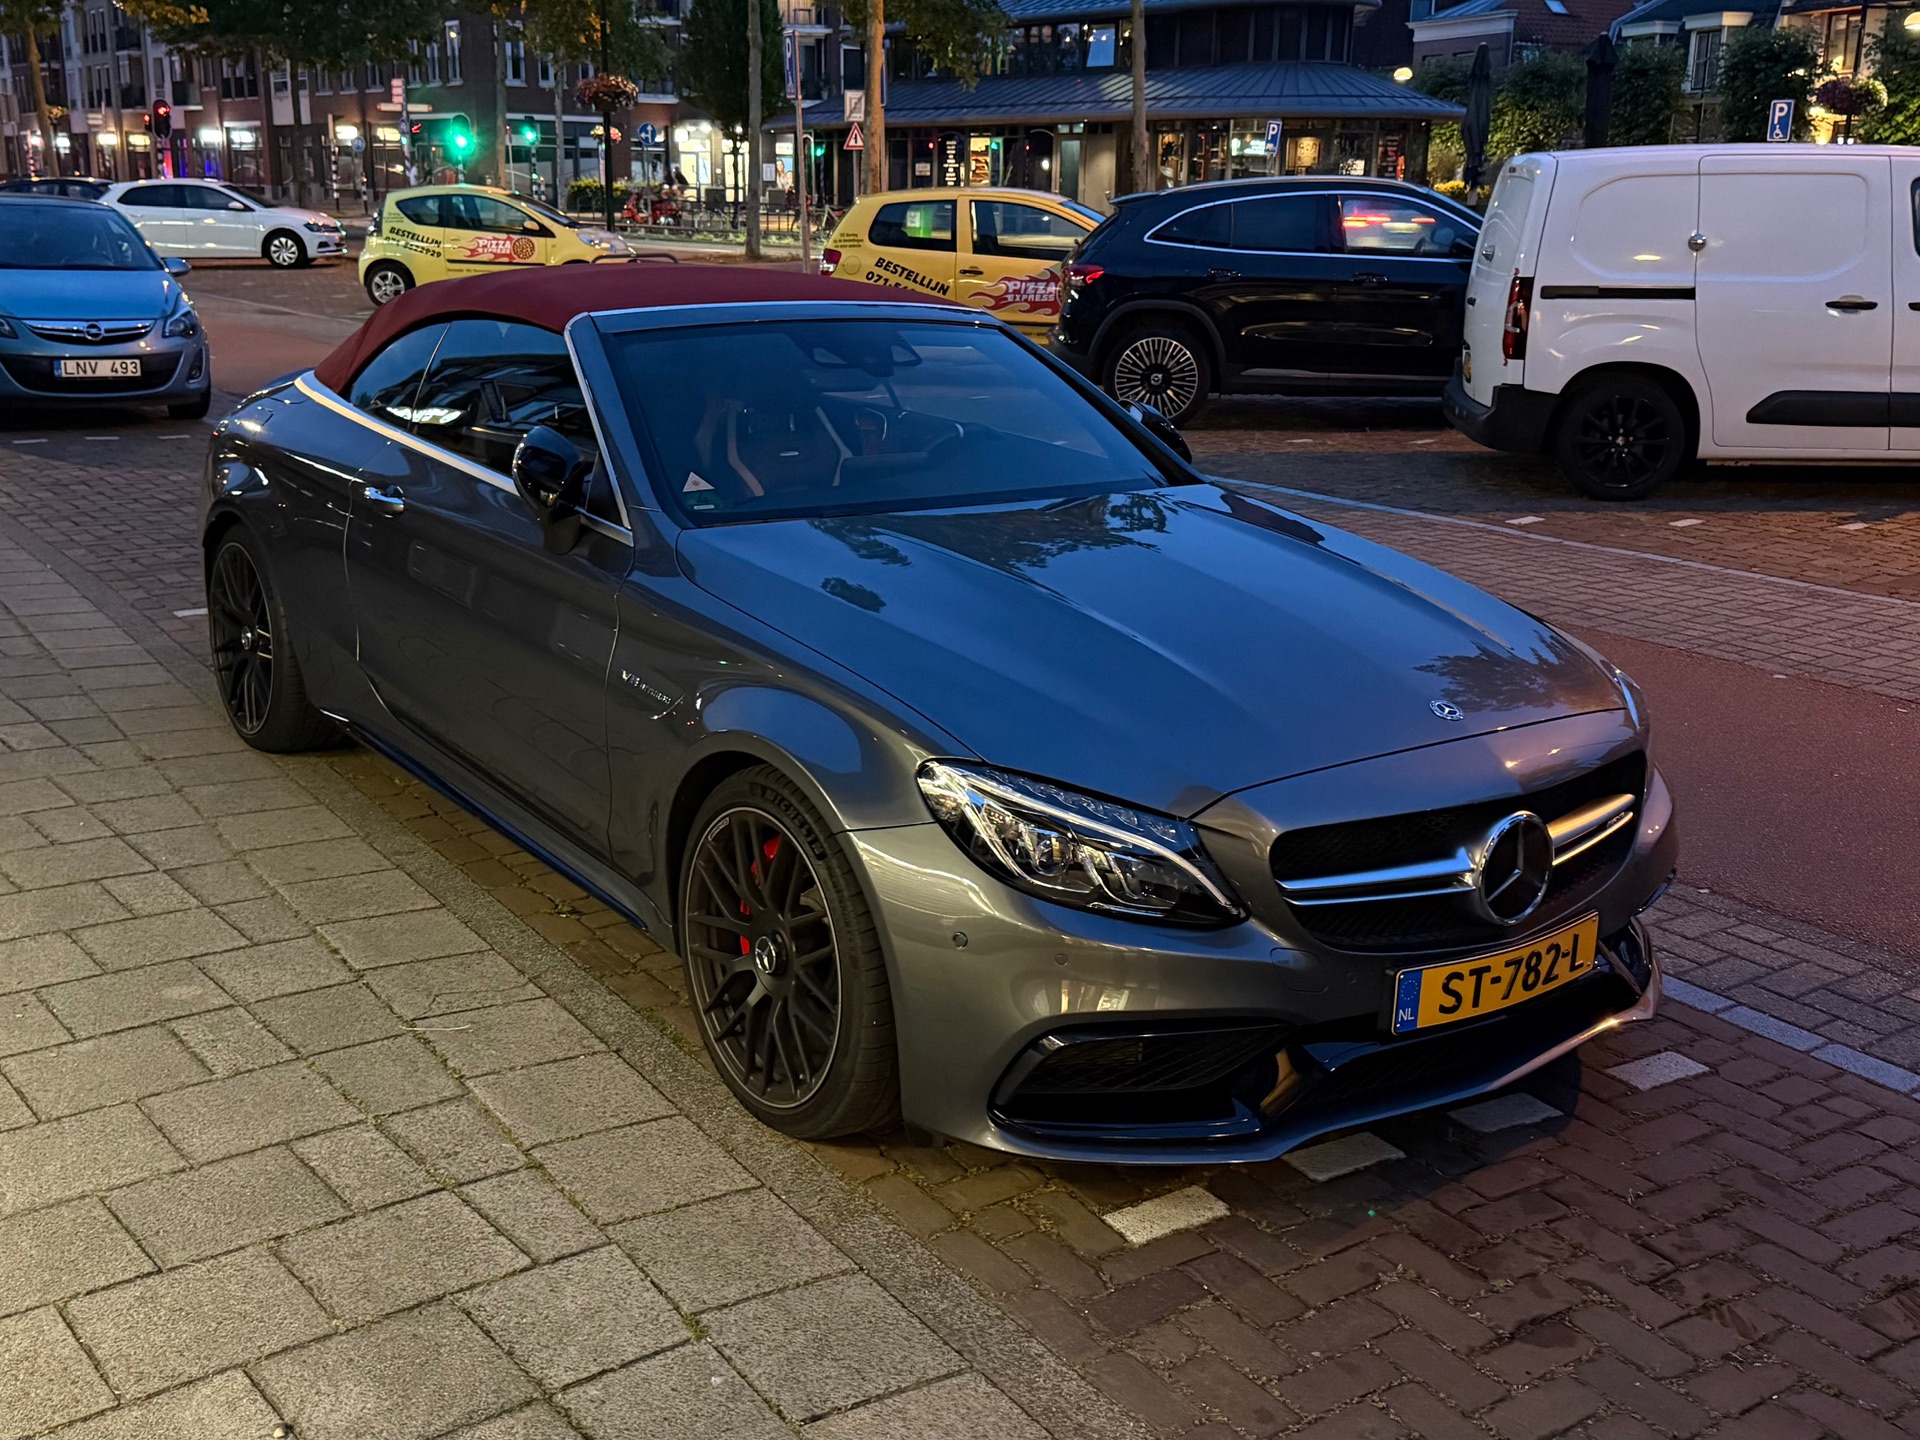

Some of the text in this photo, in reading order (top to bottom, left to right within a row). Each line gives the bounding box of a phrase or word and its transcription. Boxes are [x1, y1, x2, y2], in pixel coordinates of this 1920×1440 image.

[1774, 103, 1788, 124] P
[1267, 124, 1278, 141] P
[389, 226, 442, 249] BESTELLIJN
[478, 239, 511, 249] PIZZA
[874, 257, 950, 296] BESTELLIJN
[1007, 281, 1056, 294] PIZZA
[1006, 294, 1055, 302] EXPRESS
[63, 361, 138, 375] LNV 493
[1438, 933, 1584, 1015] ST-782-L
[1398, 1007, 1415, 1022] NL
